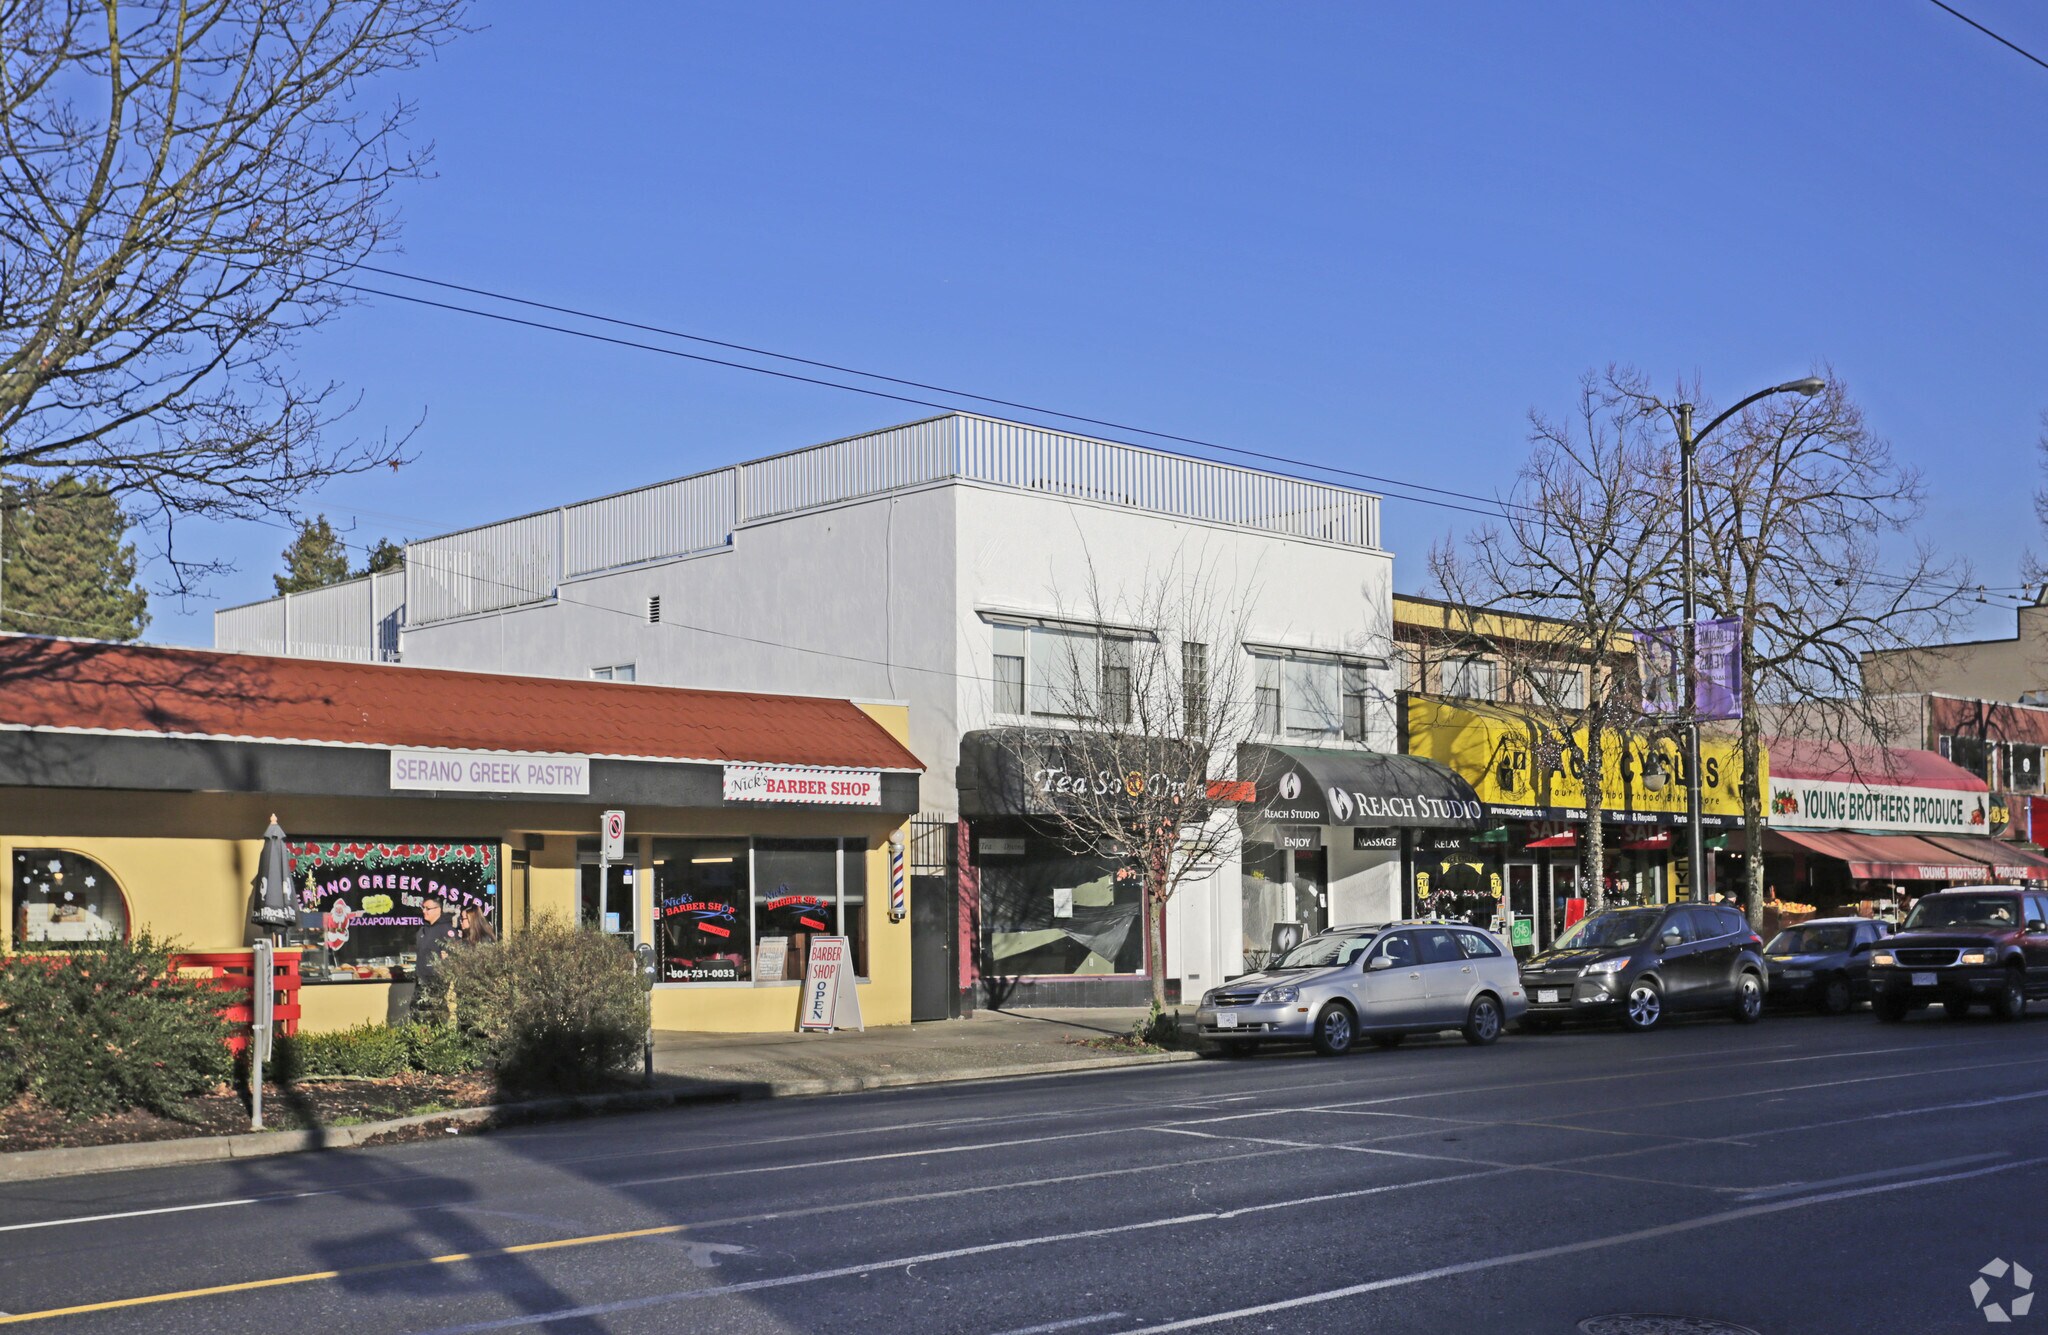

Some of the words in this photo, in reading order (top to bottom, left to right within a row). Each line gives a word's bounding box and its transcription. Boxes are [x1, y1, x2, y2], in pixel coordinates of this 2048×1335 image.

[397, 759, 462, 782] SERANO
[470, 762, 521, 784] GREEK
[528, 764, 582, 786] PASTRY
[1034, 767, 1086, 793] Tea
[731, 772, 767, 793] Nick's
[766, 779, 827, 795] BARBER
[831, 781, 870, 796] SHOP
[1354, 793, 1416, 817] REACH
[1420, 795, 1482, 819] STUDIO
[1803, 789, 1845, 819] YOUNG
[1849, 793, 1910, 823] BROTHERS
[1913, 798, 1963, 825] PRODUCE
[1264, 809, 1288, 818] REACH
[1291, 809, 1320, 819] STUDIO
[1284, 836, 1311, 848] ENJOY
[1358, 837, 1397, 847] MASSAGE
[1434, 839, 1460, 849] RELAX
[1918, 866, 1946, 878] YOUNG
[1948, 866, 1987, 879] BROTHERS
[1995, 866, 2028, 878] PRODUCE
[358, 874, 423, 892] GREEK
[663, 893, 693, 907] Nick's
[767, 895, 802, 911] BARBER
[665, 902, 706, 916] BARBER
[811, 946, 842, 961] BARBER
[813, 964, 836, 979] SHOP
[813, 981, 827, 1019] OPEN
